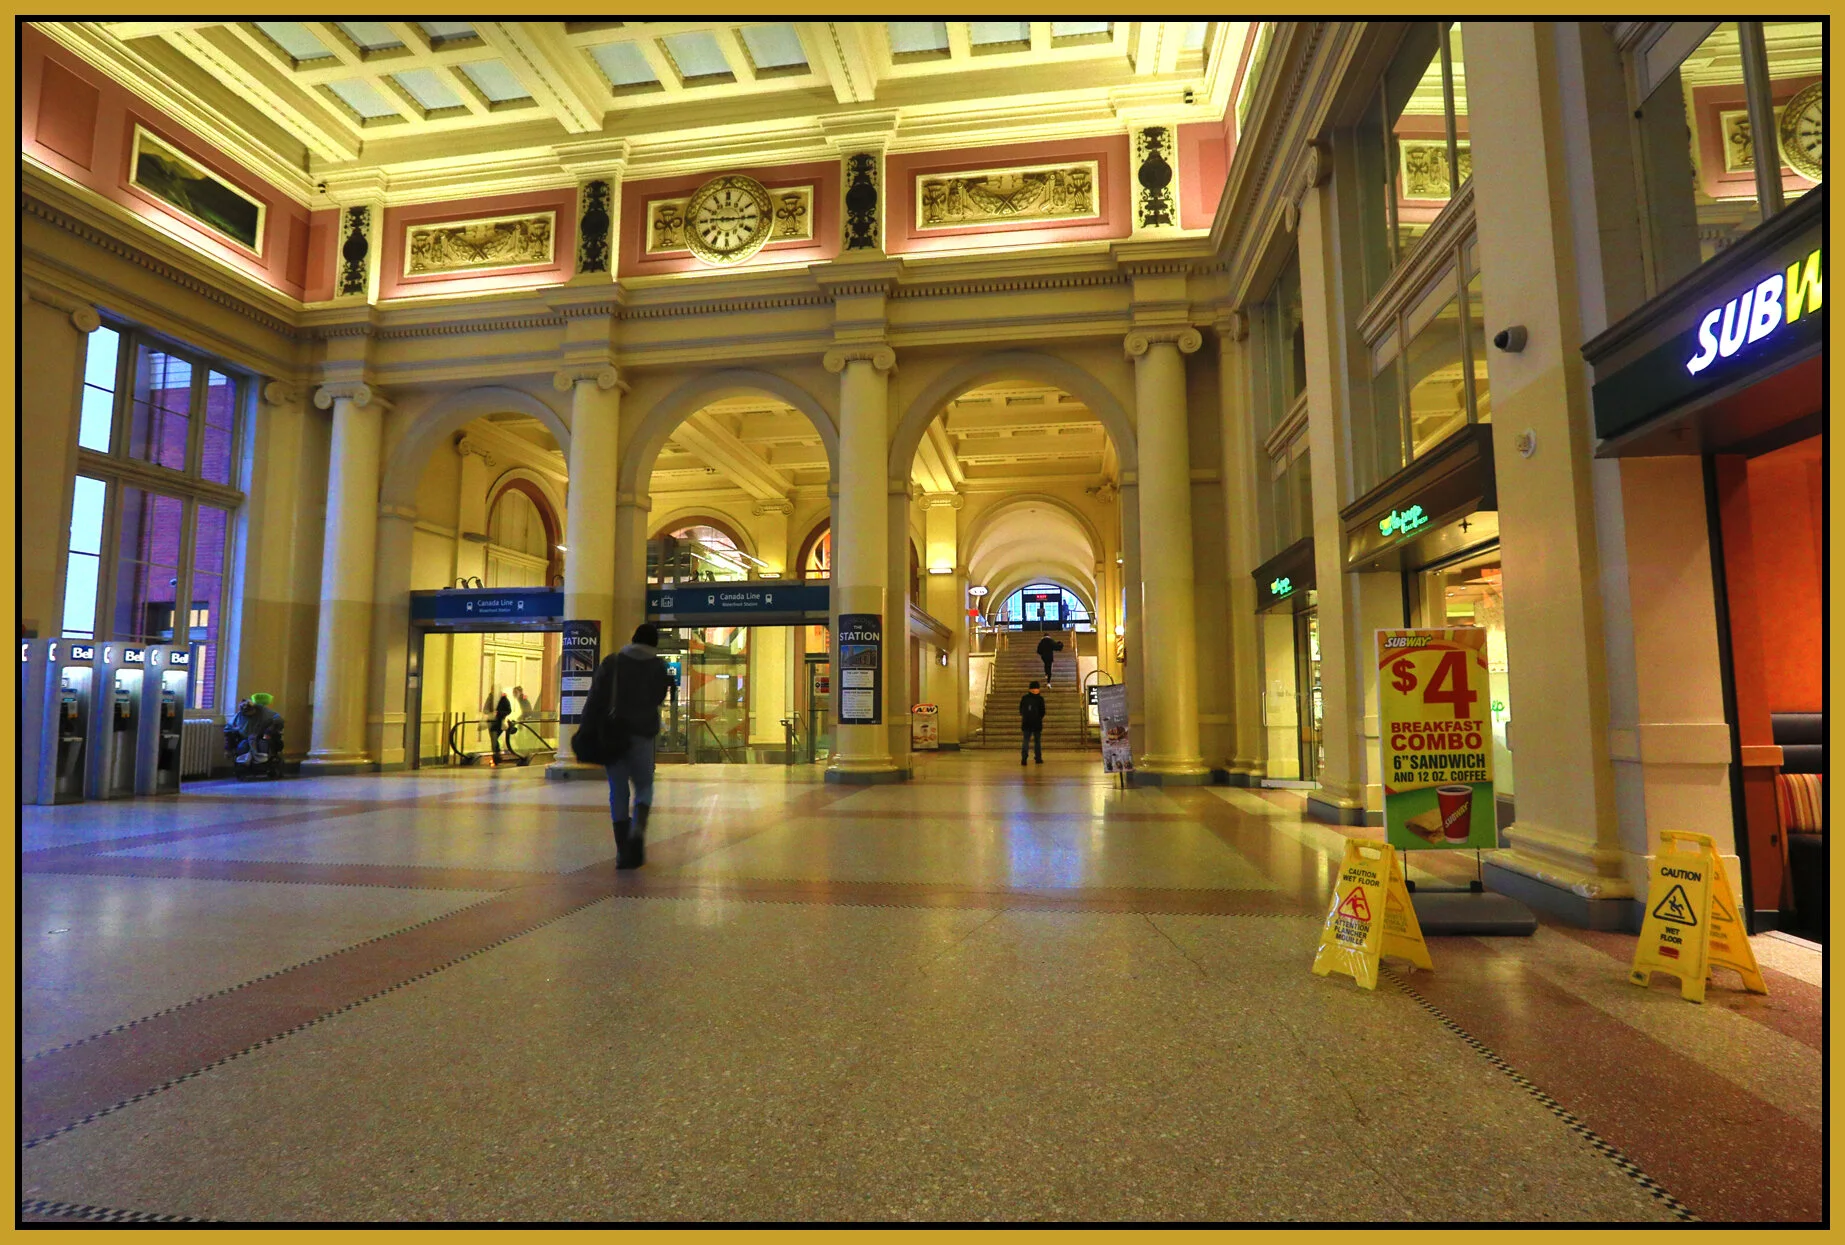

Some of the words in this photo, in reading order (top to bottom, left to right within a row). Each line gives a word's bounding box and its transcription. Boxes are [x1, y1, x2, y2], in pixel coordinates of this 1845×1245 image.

[746, 592, 760, 600] Line
[563, 636, 597, 646] TATION
[840, 631, 880, 641] STATION
[1385, 635, 1432, 648] SUBWAY
[1391, 720, 1484, 734] BREAKFAST
[1391, 732, 1483, 751] COMBO
[1393, 772, 1414, 783] AND
[1417, 772, 1429, 782] 12
[1432, 771, 1448, 782] OZ.
[1450, 770, 1487, 781] COFFEE
[1444, 801, 1470, 828] SUBWAY
[1348, 867, 1377, 879] CAUTION
[1660, 867, 1701, 882] CAUTION
[1343, 874, 1356, 883] WET
[1358, 877, 1380, 888] FLOOR
[1334, 926, 1367, 940] PLANCHER
[1665, 927, 1680, 935] WET
[1660, 933, 1683, 945] FLOOR
